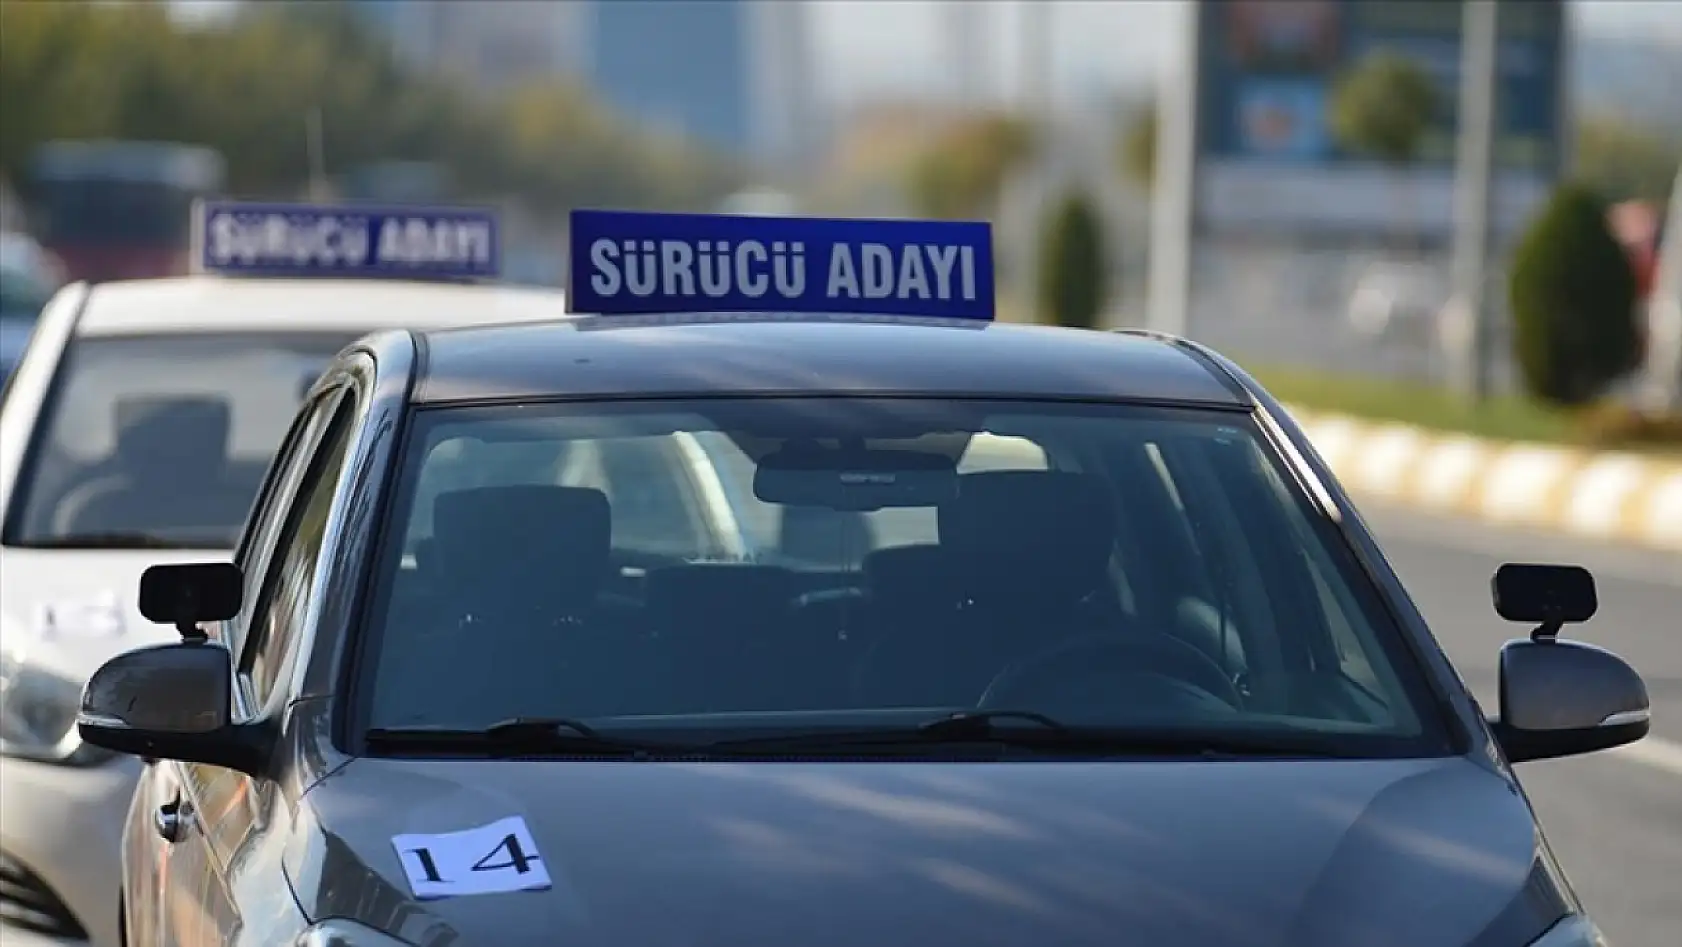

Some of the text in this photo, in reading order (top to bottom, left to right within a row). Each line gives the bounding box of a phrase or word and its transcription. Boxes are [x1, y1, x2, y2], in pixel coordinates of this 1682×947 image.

[379, 215, 490, 264] ADAYI
[590, 239, 976, 300] SÜRÜCÜ ADAYI
[404, 833, 539, 882] 14
